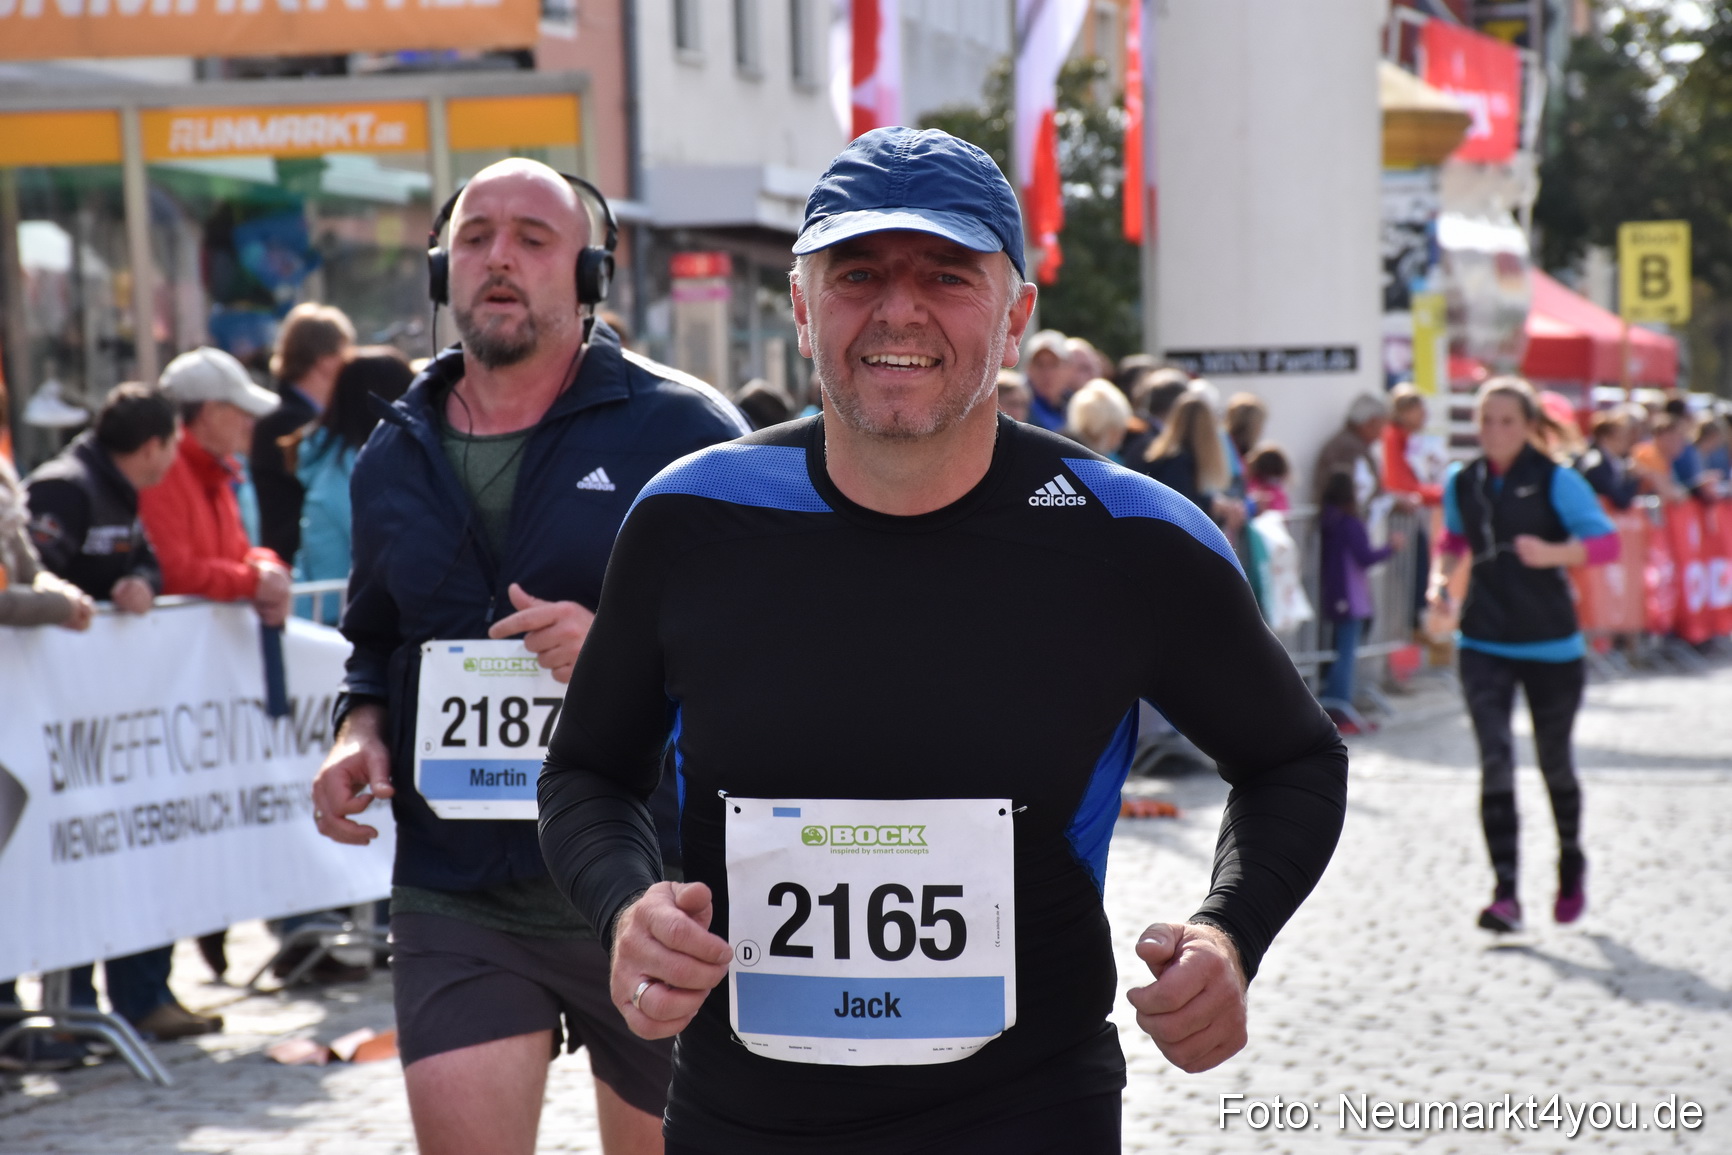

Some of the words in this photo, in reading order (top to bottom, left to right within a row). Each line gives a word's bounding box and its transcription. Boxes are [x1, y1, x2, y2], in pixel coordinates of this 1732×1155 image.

[1638, 253, 1672, 300] B
[1028, 493, 1087, 507] adidas
[480, 657, 538, 672] BOCK
[441, 696, 564, 748] 2187
[469, 768, 527, 787] Martin
[830, 825, 928, 846] BOCK
[830, 847, 860, 856] inspired
[861, 847, 871, 856] by
[895, 848, 929, 856] concepts
[767, 881, 967, 962] 2165
[743, 946, 752, 961] D
[834, 991, 902, 1019] Jack
